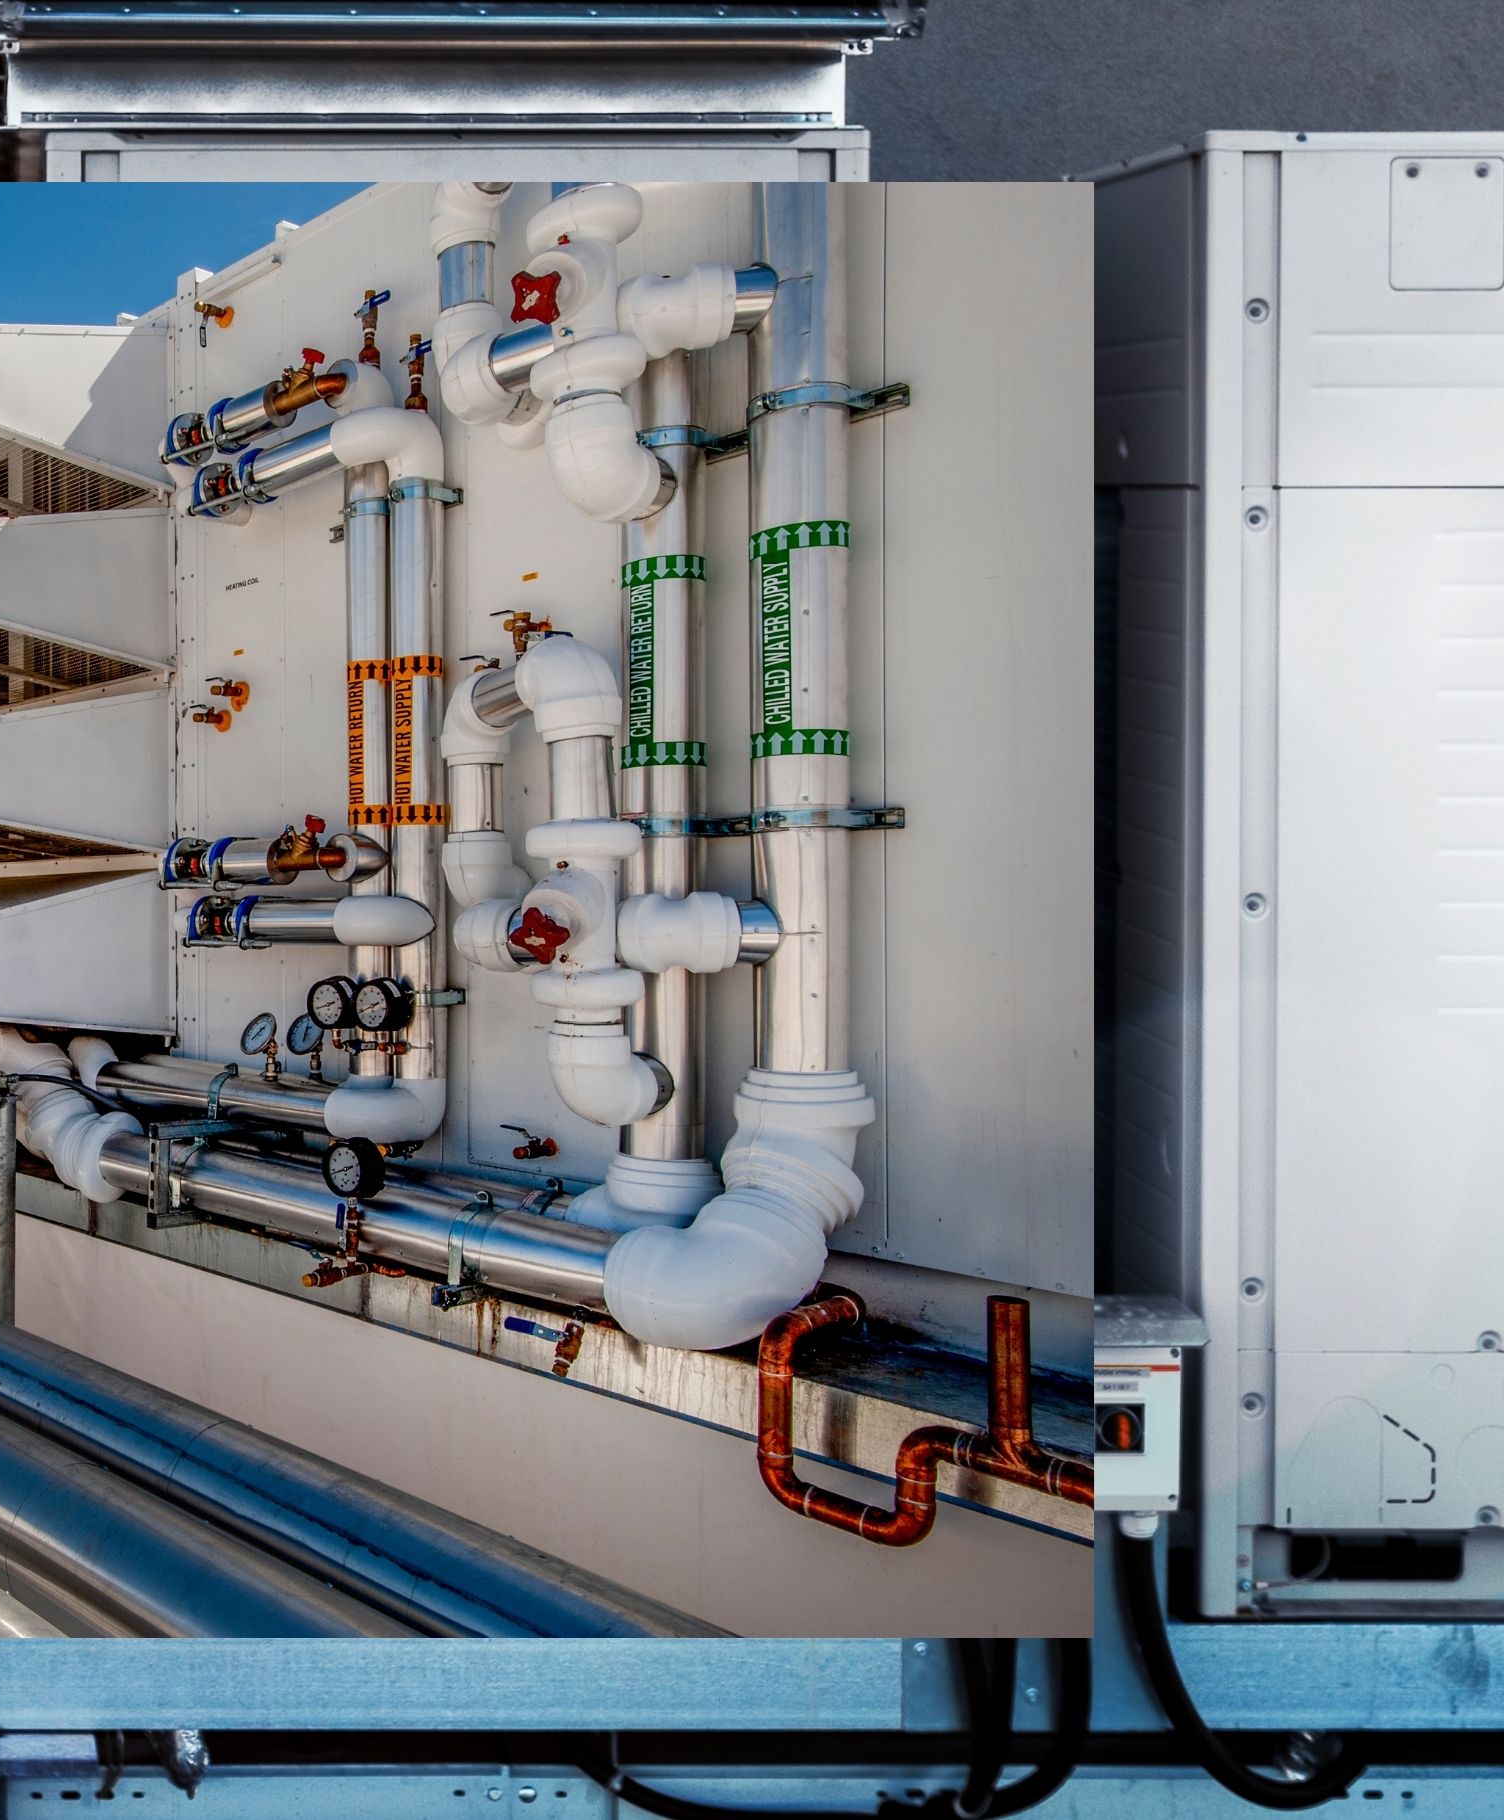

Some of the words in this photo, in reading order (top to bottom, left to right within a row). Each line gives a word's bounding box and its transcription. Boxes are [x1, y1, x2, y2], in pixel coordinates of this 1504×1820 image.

[225, 580, 246, 591] HEATING
[247, 577, 259, 585] COIL
[763, 561, 789, 612] SUPPLY
[631, 583, 652, 635] RETURN
[631, 636, 652, 684] WATER
[764, 615, 789, 667] WATER
[348, 680, 363, 730] RETURN
[395, 679, 412, 726] SUPPLY
[630, 686, 652, 737] CHILLED
[765, 669, 791, 725] CHILLED
[349, 734, 363, 777] WATER
[395, 731, 411, 776] WATER
[349, 780, 363, 805] HOT
[395, 780, 411, 805] HOT
